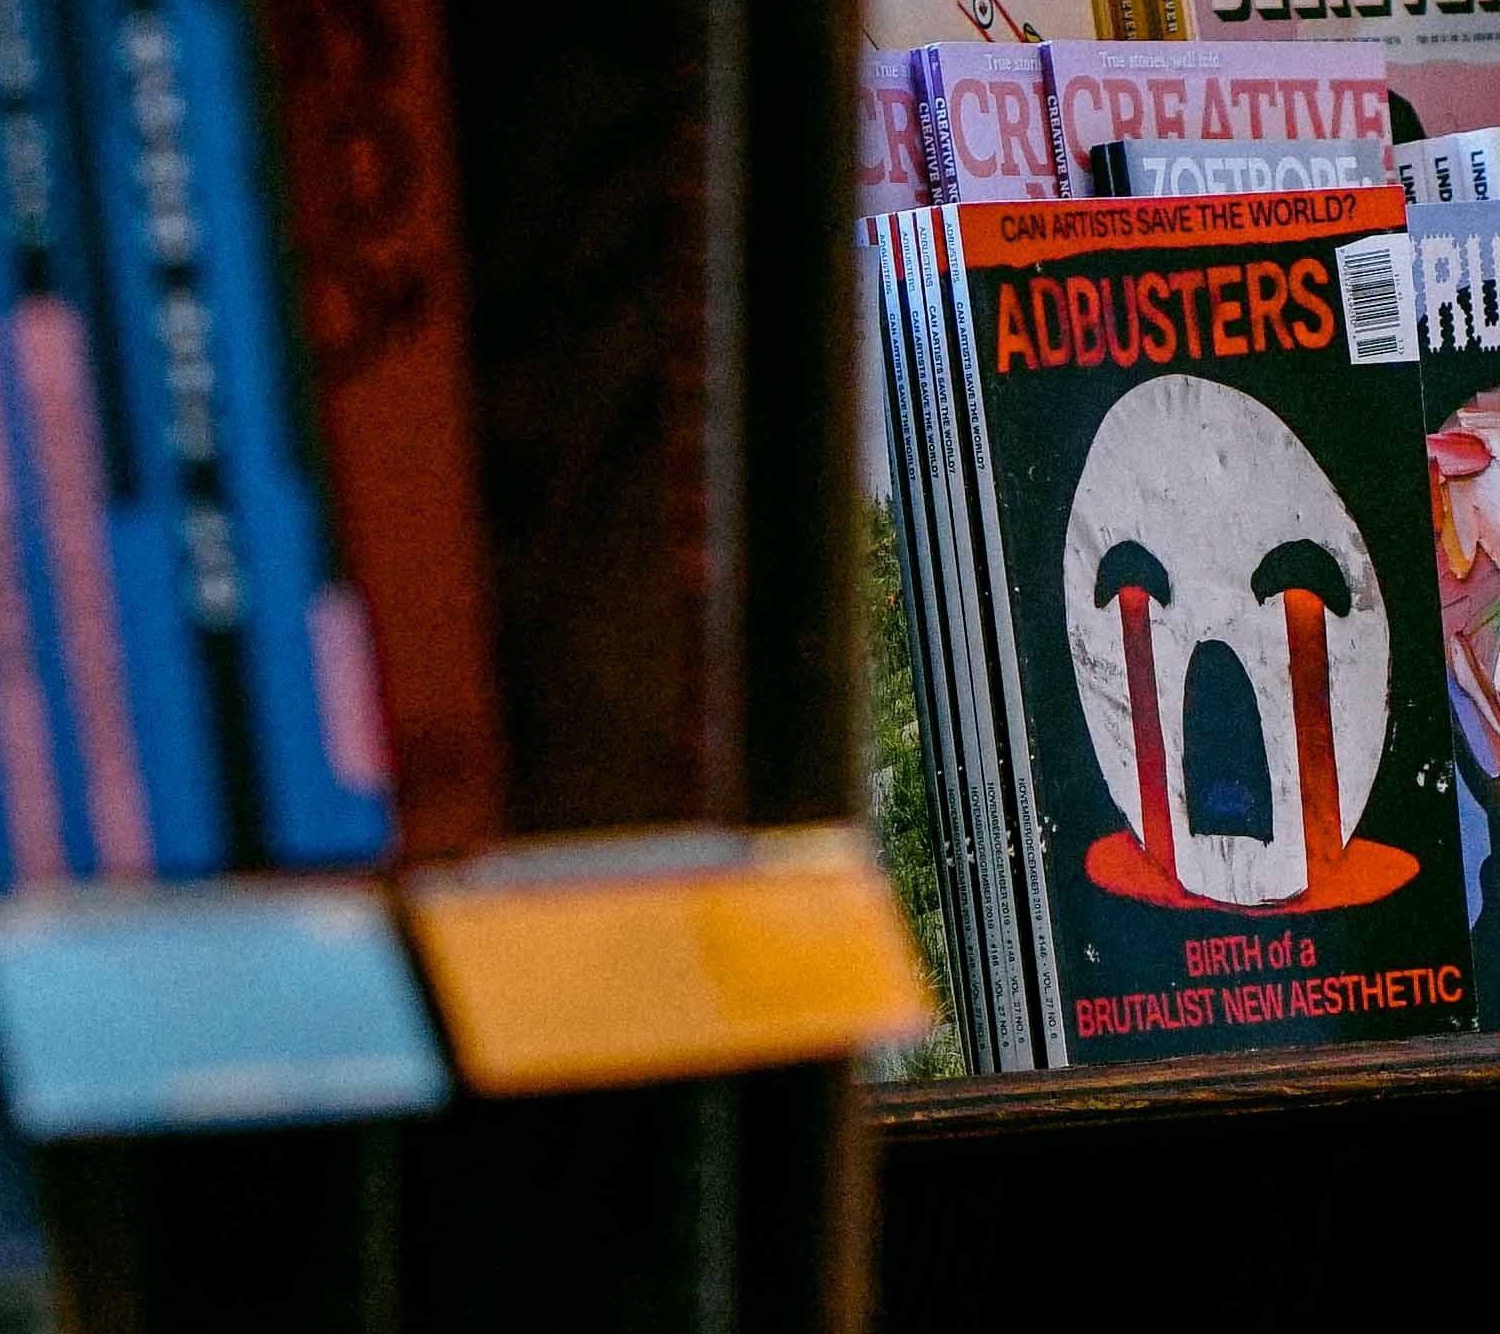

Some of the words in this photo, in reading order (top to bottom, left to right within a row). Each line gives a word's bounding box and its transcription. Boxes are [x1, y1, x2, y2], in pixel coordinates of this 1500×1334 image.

[1099, 51, 1125, 68] True
[918, 102, 940, 182] CREATIVE
[934, 97, 958, 188] CREATIVE
[1046, 94, 1069, 176] CREATIVE
[1001, 213, 1047, 244] CAN
[1052, 208, 1134, 239] ARTISTS
[1136, 206, 1191, 237] SAVE
[1197, 203, 1245, 231] THE
[1248, 193, 1357, 228] WORLD?
[997, 257, 1336, 374] ADBUSTERS
[1184, 934, 1263, 978] BIRTH
[1268, 929, 1295, 969] of
[1298, 936, 1317, 968] a
[1075, 986, 1215, 1039] BRUTALIST
[1222, 982, 1285, 1026] NEW
[1289, 964, 1464, 1018] AESTHETIC
